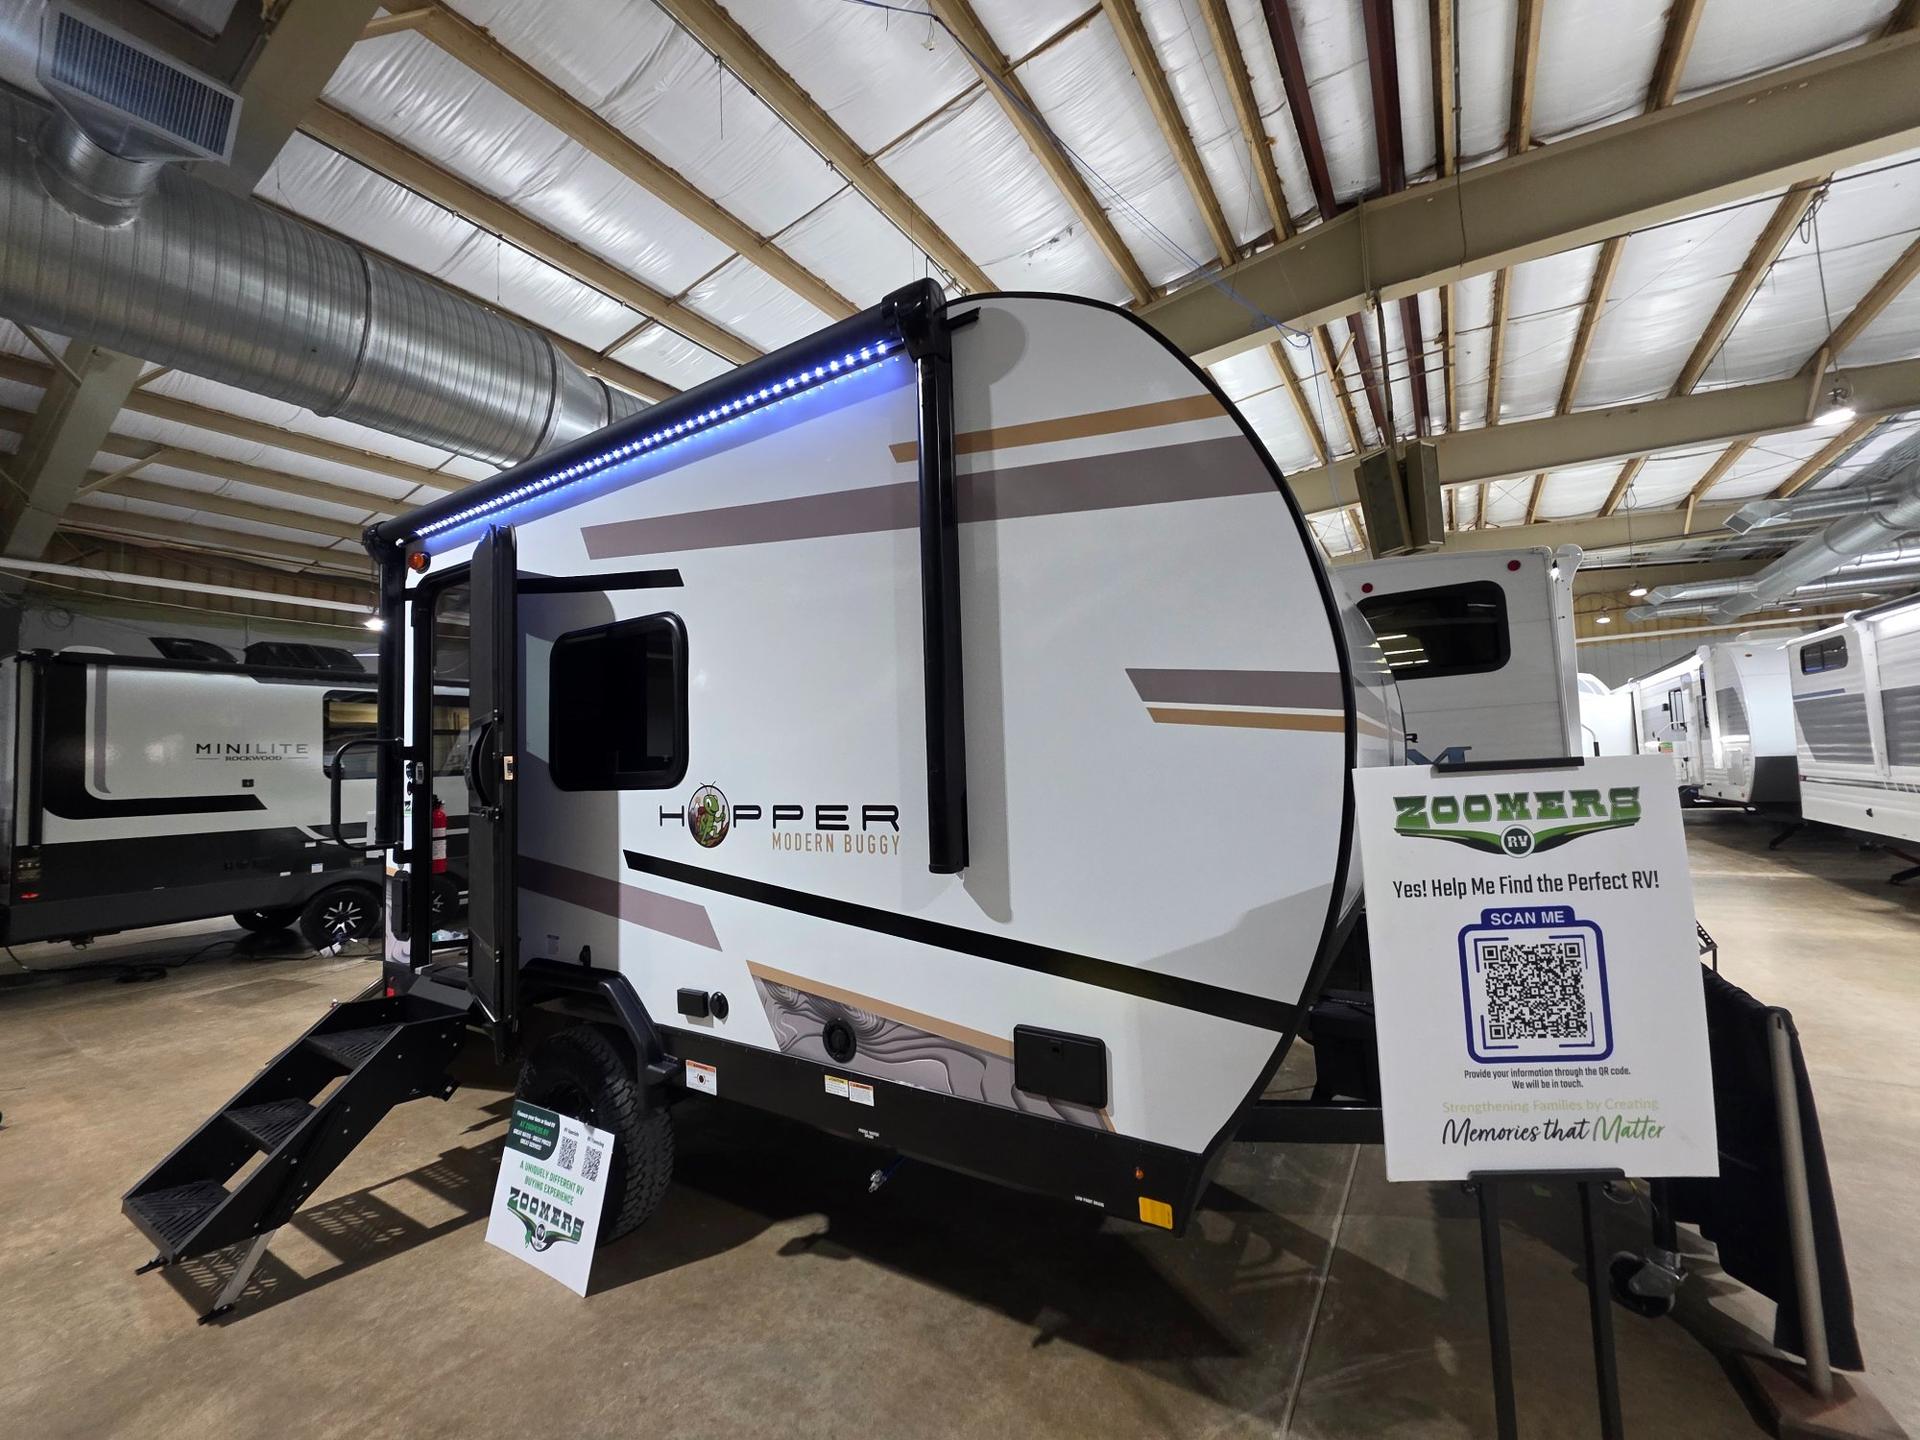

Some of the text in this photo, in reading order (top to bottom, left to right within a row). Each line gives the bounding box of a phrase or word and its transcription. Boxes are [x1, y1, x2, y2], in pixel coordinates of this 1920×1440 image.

[1392, 786, 1642, 830] ZOOMERS
[772, 831, 901, 856] MODERN BUGGY
[1506, 834, 1529, 848] RV
[1393, 869, 1660, 900] Yes! Help Me Find the Perfect RV!
[1490, 910, 1566, 926] SCAN ME
[1464, 1065, 1631, 1080] Provide your information through the QR code.
[1511, 1078, 1584, 1089] We will be in touch.
[1442, 1097, 1659, 1114] Strengthening Families by Creating
[1442, 1114, 1666, 1147] Memories that Matter
[525, 1162, 549, 1180] UNIQUELY
[549, 1172, 577, 1192] DIFFERENT
[543, 1183, 575, 1206] EXPERIENCE
[507, 1186, 585, 1242] ZOOMERS
